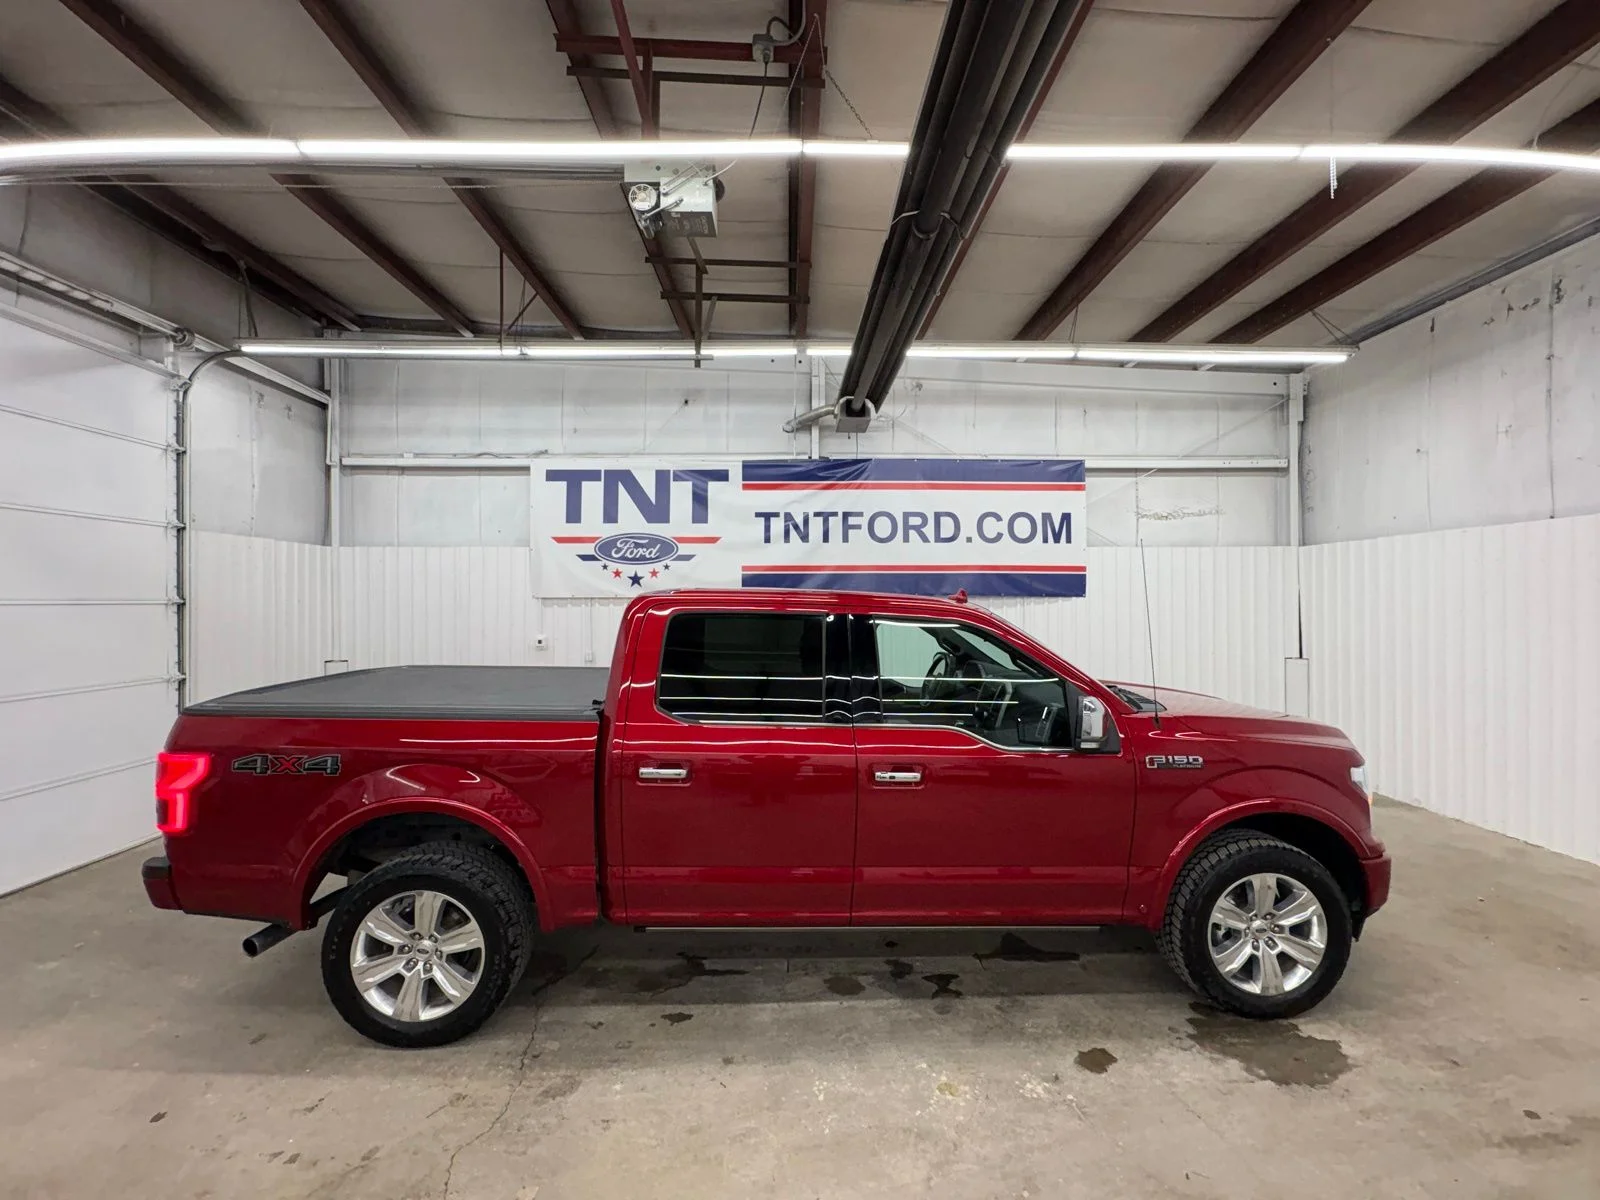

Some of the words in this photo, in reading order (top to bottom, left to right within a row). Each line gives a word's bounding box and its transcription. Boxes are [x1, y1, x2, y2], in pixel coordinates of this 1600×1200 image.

[545, 469, 730, 525] TNT
[754, 511, 1073, 545] TNTFORD.COM
[611, 538, 661, 559] Ford
